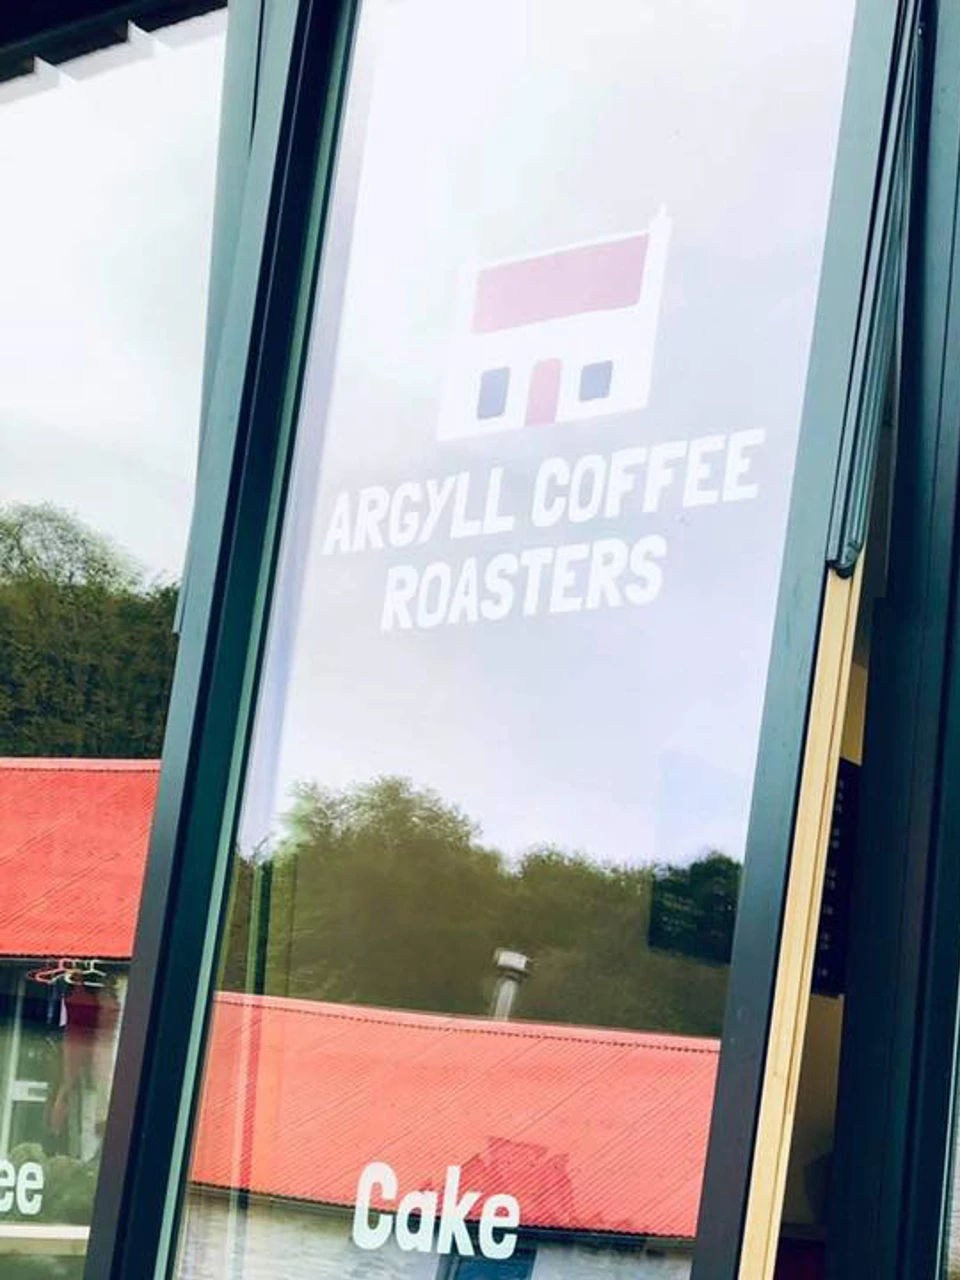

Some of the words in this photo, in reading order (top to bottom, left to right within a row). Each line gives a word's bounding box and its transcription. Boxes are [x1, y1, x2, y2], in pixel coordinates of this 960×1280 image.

[321, 467, 516, 556] ARGYLL
[530, 427, 767, 528] COFFEE
[380, 534, 668, 633] ROASTERS
[352, 1161, 520, 1260] Cake
